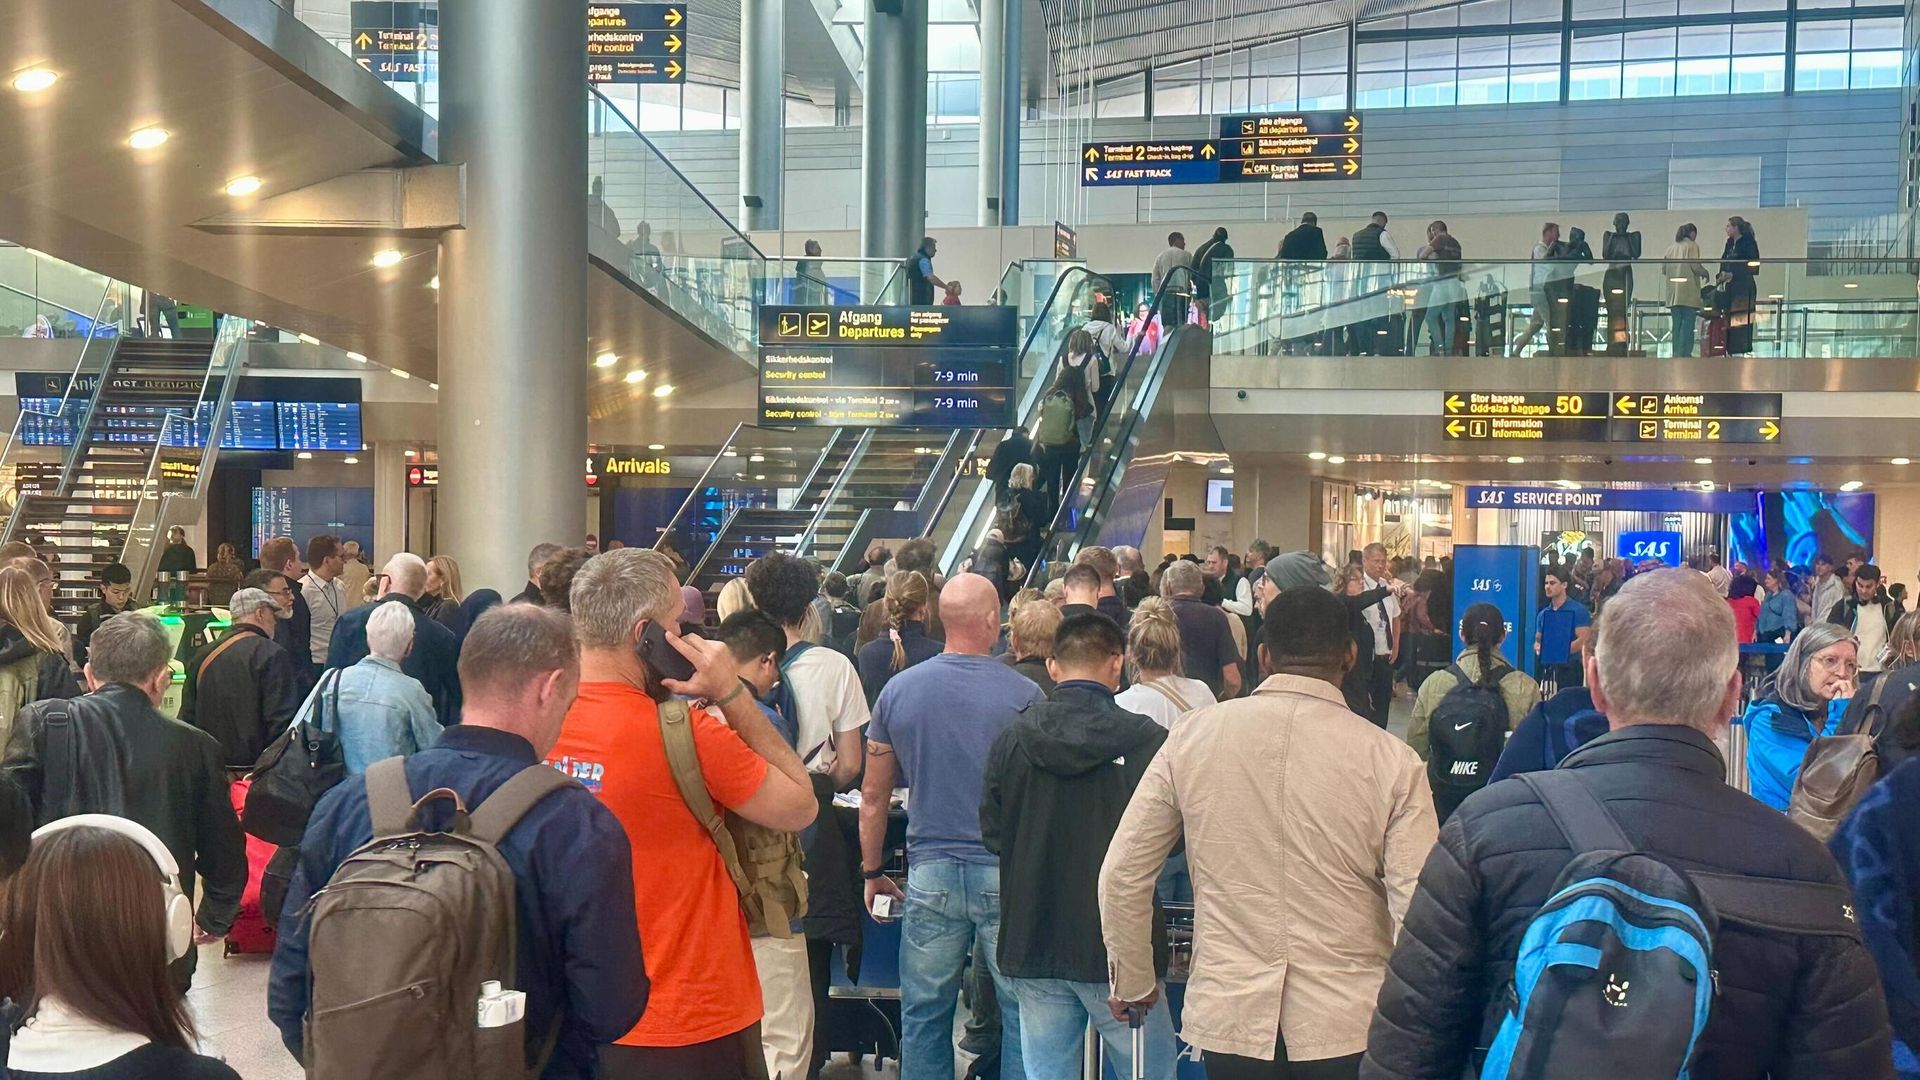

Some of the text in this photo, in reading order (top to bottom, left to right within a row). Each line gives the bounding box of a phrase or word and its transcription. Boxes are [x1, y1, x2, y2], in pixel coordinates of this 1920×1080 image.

[588, 18, 626, 27] partures
[378, 31, 414, 40] Terminal
[416, 33, 428, 50] 2
[588, 32, 643, 42] rhedskontrol
[378, 41, 414, 50] Terminal
[588, 43, 634, 53] rity control
[589, 64, 613, 72] press
[1269, 126, 1308, 135] departures
[1104, 145, 1133, 153] Terminal
[1135, 145, 1145, 160] 2
[1259, 146, 1312, 155] Security control
[1104, 168, 1172, 179] SAS FAST TRACK
[839, 310, 882, 325] Afgang
[839, 325, 905, 340] Departures
[765, 355, 833, 364] Sikkerhedskontrol
[765, 370, 826, 380] Security control
[934, 371, 979, 381] 7-9 min
[847, 396, 877, 404] Terminal
[934, 398, 978, 408] 7-9 min
[1470, 394, 1525, 405] Stor bagage
[1664, 394, 1704, 404] Ankomst
[1470, 395, 1583, 415] Odd-size baggage 50
[1664, 404, 1698, 414] Arrivals
[765, 410, 795, 419] Security
[796, 409, 822, 418] control
[1492, 418, 1543, 428] Information
[1492, 428, 1543, 438] Information
[1663, 419, 1720, 439] Terminal 2
[1663, 429, 1702, 439] Terminal
[606, 457, 671, 474] Arrivals
[1477, 490, 1602, 506] SAS SERVICE POINT
[1629, 541, 1671, 557] SAS
[1471, 578, 1492, 591] SAS
[1450, 760, 1478, 775] NIKE
